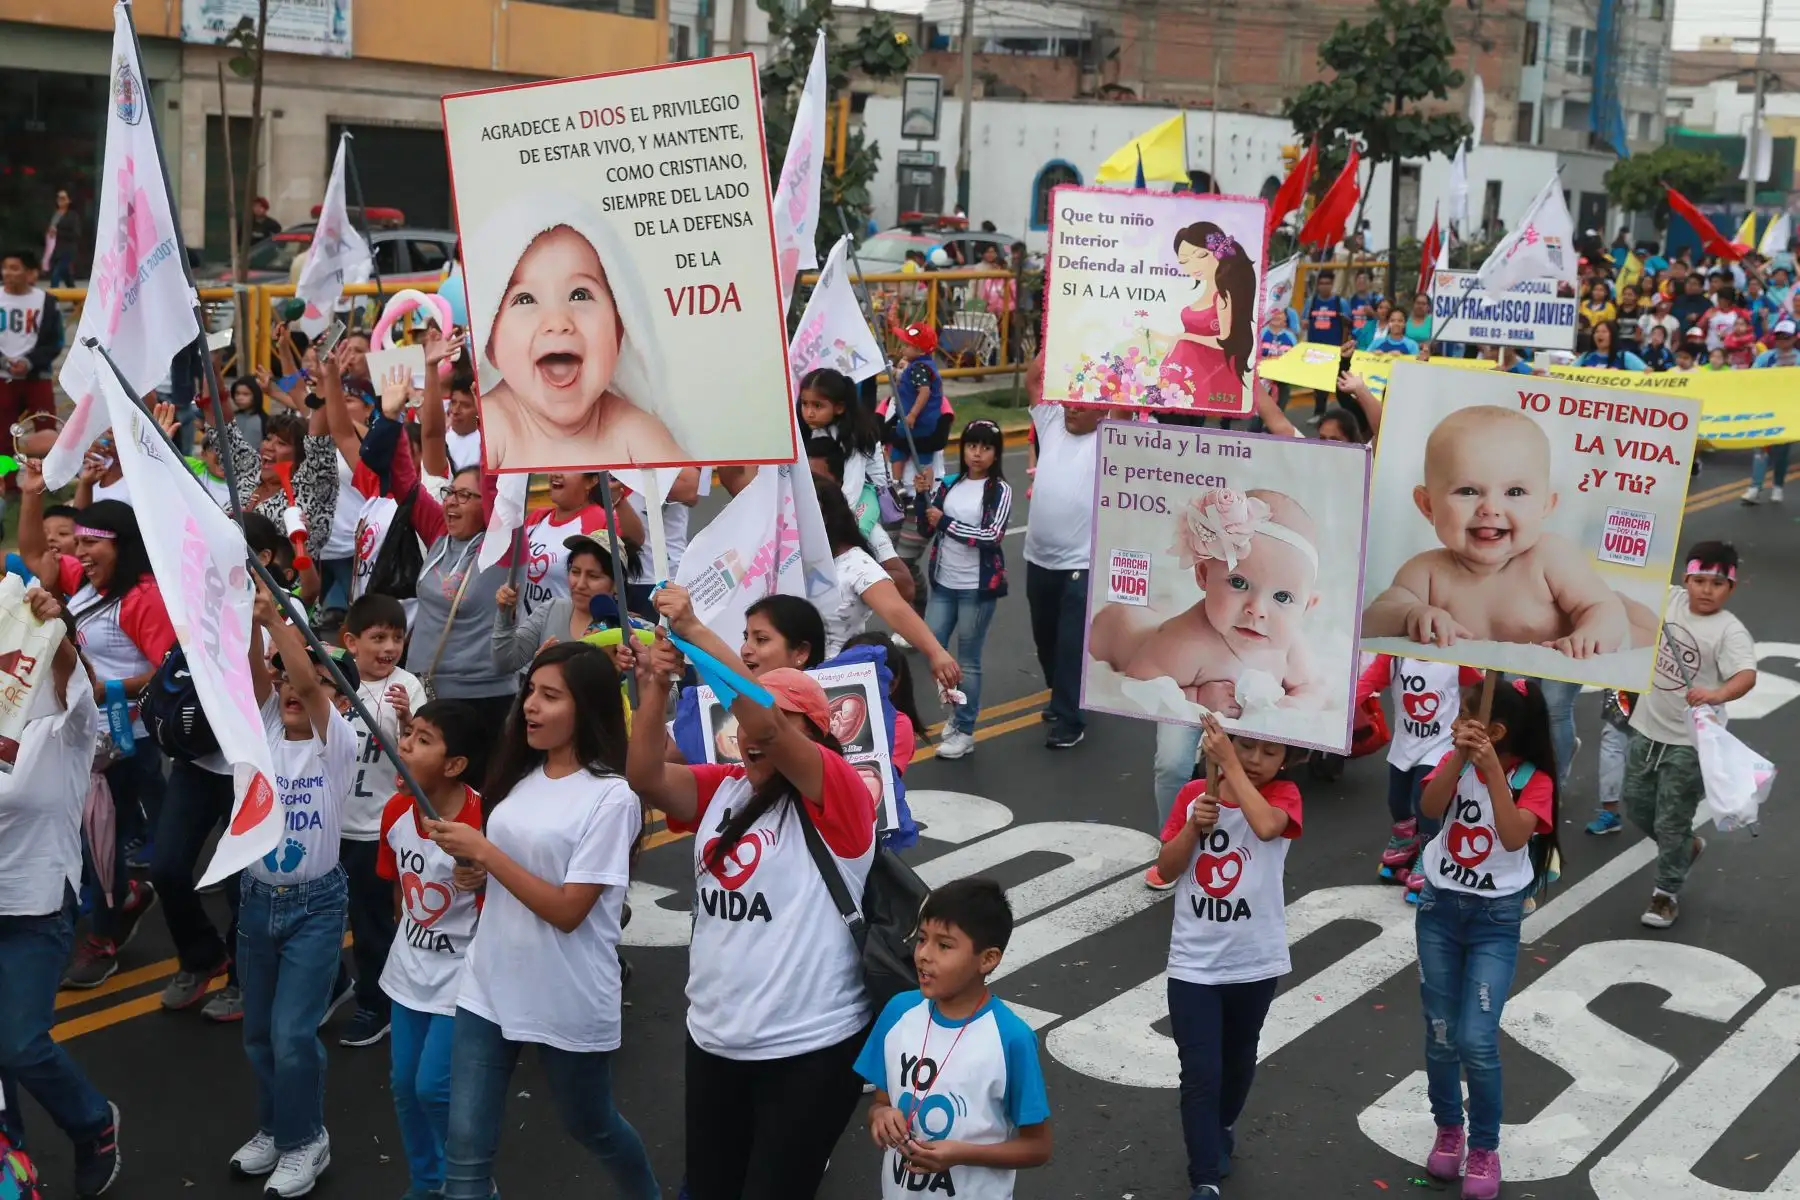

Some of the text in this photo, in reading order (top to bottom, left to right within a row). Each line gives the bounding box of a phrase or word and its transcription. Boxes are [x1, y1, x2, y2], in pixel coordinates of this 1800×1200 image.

[481, 94, 740, 141] AGRADECE A DIOS EL PRIVILEGIO
[519, 124, 744, 165] DE ESTAR VIVO, Y MANTENTE,
[606, 153, 748, 183] COMO CRISTIANO,
[602, 182, 751, 212] SIEMPRE DEL LADO
[634, 211, 754, 237] DE LA DEFENSA
[1061, 208, 1154, 227] Que tu niño
[1059, 231, 1118, 249] Interior
[675, 250, 721, 269] DE LA
[1058, 255, 1191, 278] Defienda al mio...
[664, 282, 742, 317] VIDA
[1062, 282, 1167, 303] SI A LA VIDA
[1461, 298, 1530, 324] FRANCISCO
[1532, 301, 1574, 327] JAVIER
[1635, 374, 1689, 388] JAVIER
[1516, 390, 1689, 431] YO DEFIENDO
[1103, 427, 1252, 459] Tu vida y la mia
[1574, 433, 1681, 466] LA VIDA.
[1102, 457, 1227, 489] le pertenecen
[1578, 468, 1657, 495] ¿Y Tú?
[1100, 491, 1172, 515] a DIOS.
[1608, 514, 1651, 532] MARCHA
[1604, 532, 1647, 557] VIDA
[1112, 556, 1148, 571] MARCHA
[1111, 574, 1147, 597] VIDA
[1400, 673, 1426, 693] YO
[1403, 718, 1441, 739] VIDA
[279, 792, 312, 806] ECHO
[1455, 794, 1482, 824] YO
[400, 847, 425, 875] YO
[1439, 856, 1497, 890] VIDA
[701, 887, 773, 923] VIDA
[1190, 894, 1252, 923] VIDA
[900, 1052, 938, 1092] YO
